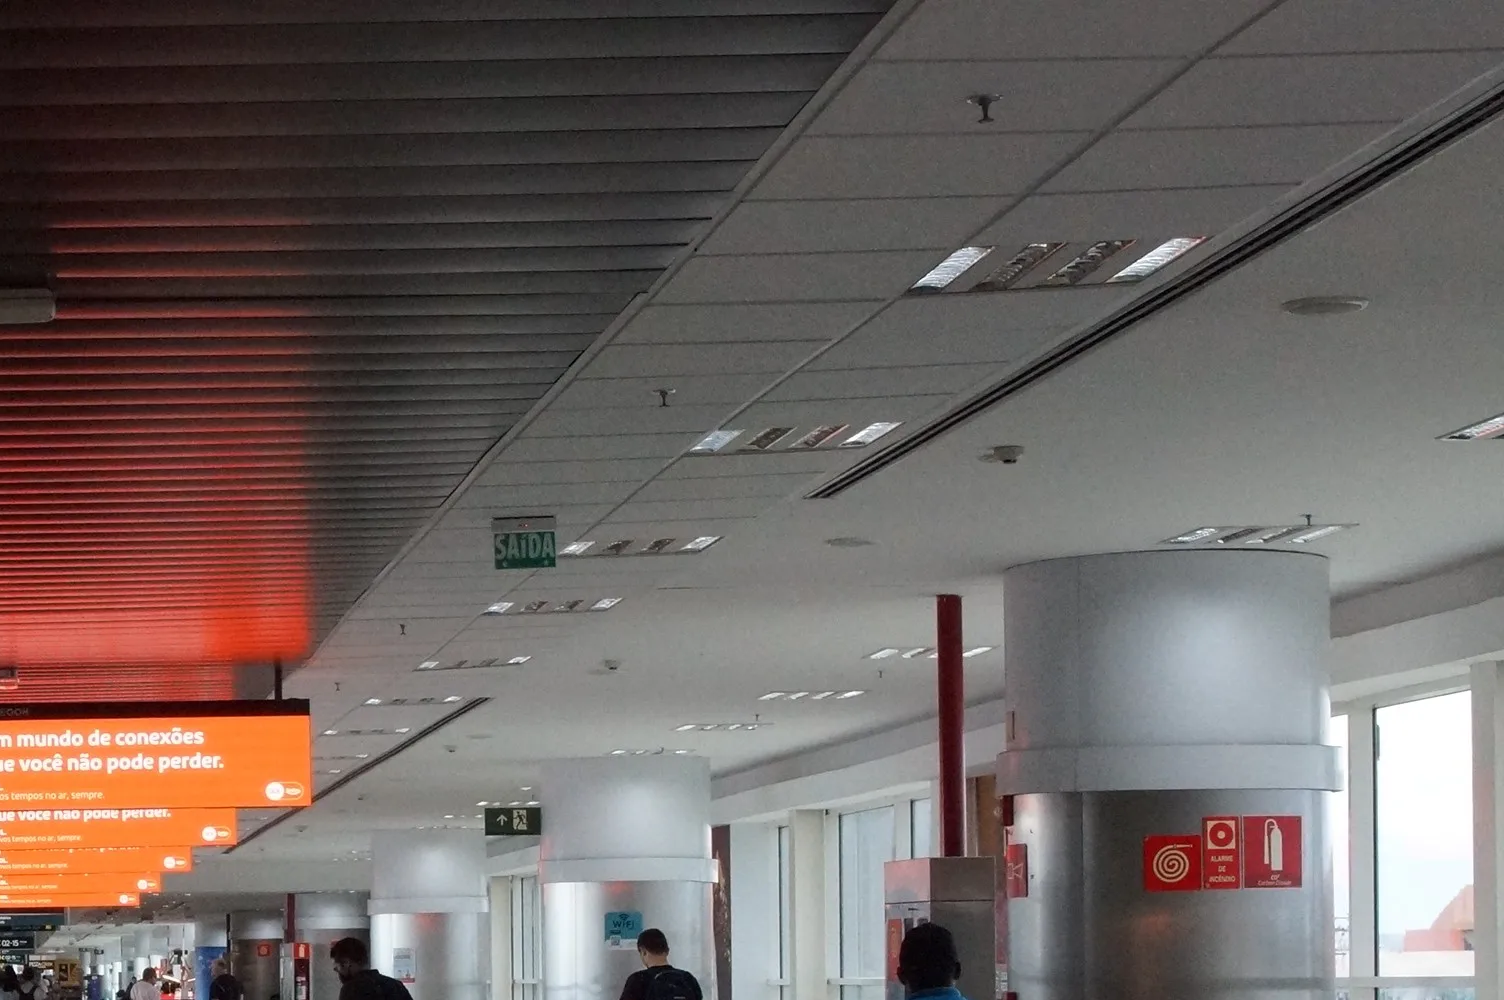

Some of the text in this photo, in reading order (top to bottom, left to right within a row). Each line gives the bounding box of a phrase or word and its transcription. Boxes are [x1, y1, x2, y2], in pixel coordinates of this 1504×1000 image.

[495, 532, 555, 560] SAÍDA
[17, 730, 84, 747] mundo
[88, 729, 111, 746] de
[115, 727, 205, 745] conexões
[19, 754, 63, 772] você
[67, 753, 102, 771] não
[107, 753, 154, 774] pode
[158, 752, 224, 773] perder.
[11, 792, 43, 802] tempos
[45, 792, 56, 800] no
[71, 790, 105, 801] sempre.
